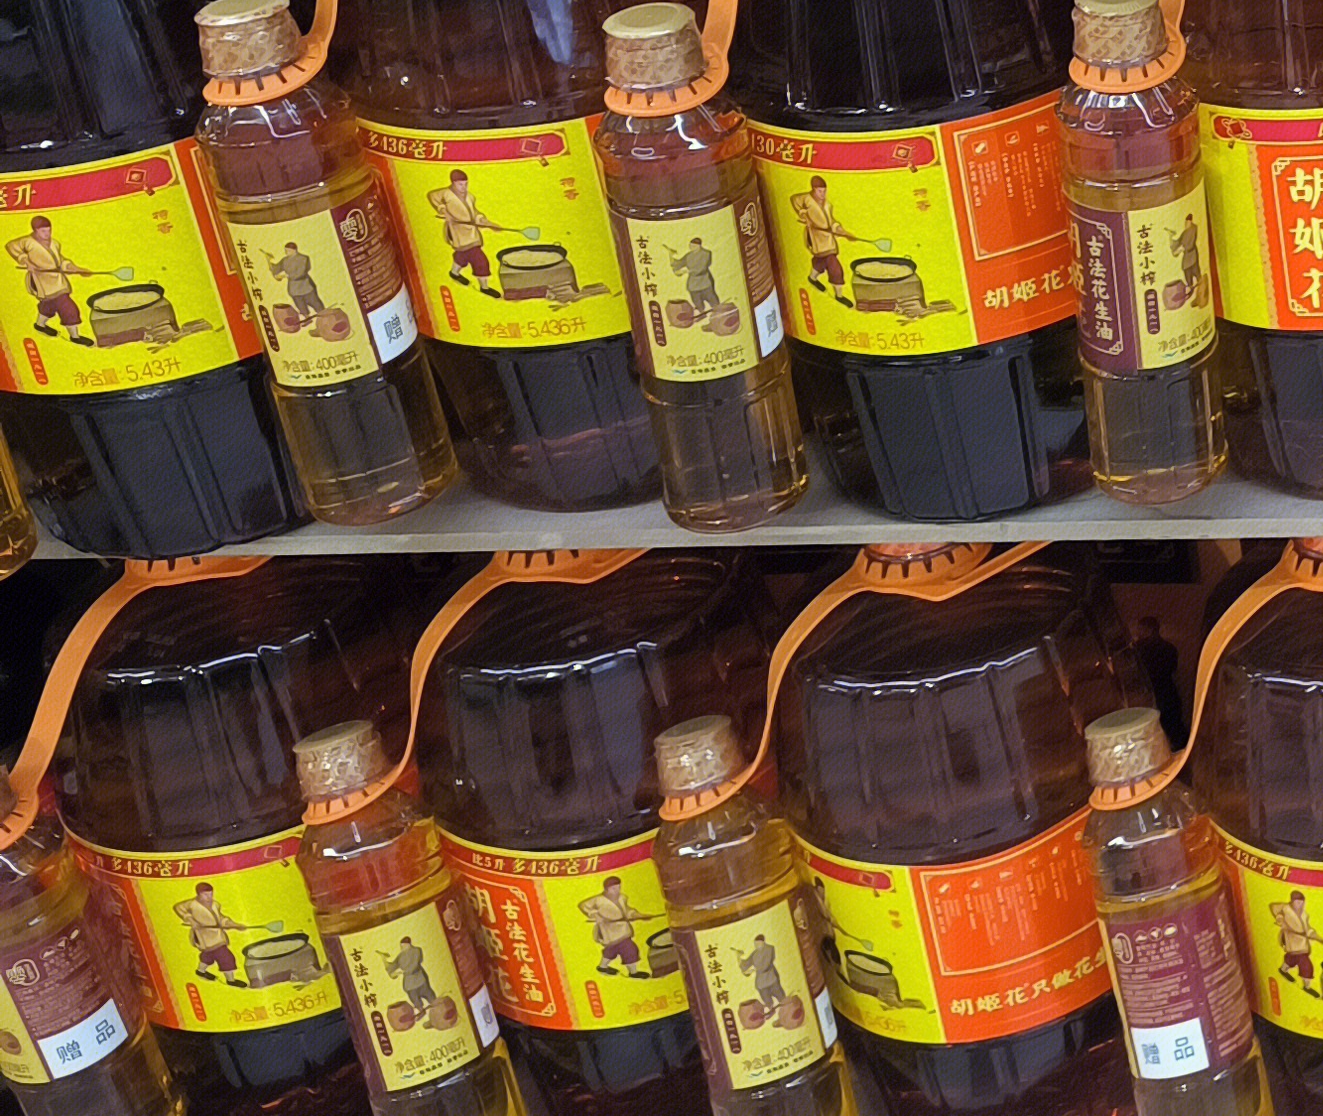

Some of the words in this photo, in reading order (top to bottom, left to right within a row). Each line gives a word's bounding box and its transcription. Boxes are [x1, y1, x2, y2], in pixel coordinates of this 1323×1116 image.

[636, 235, 659, 298] 古法小榨
[1137, 223, 1156, 287] 古法小榨
[1086, 234, 1114, 341] 古法花生油
[500, 898, 544, 1005] 古法花生油
[704, 942, 731, 1006] 古法小榨
[56, 1019, 116, 1064] 赠品
